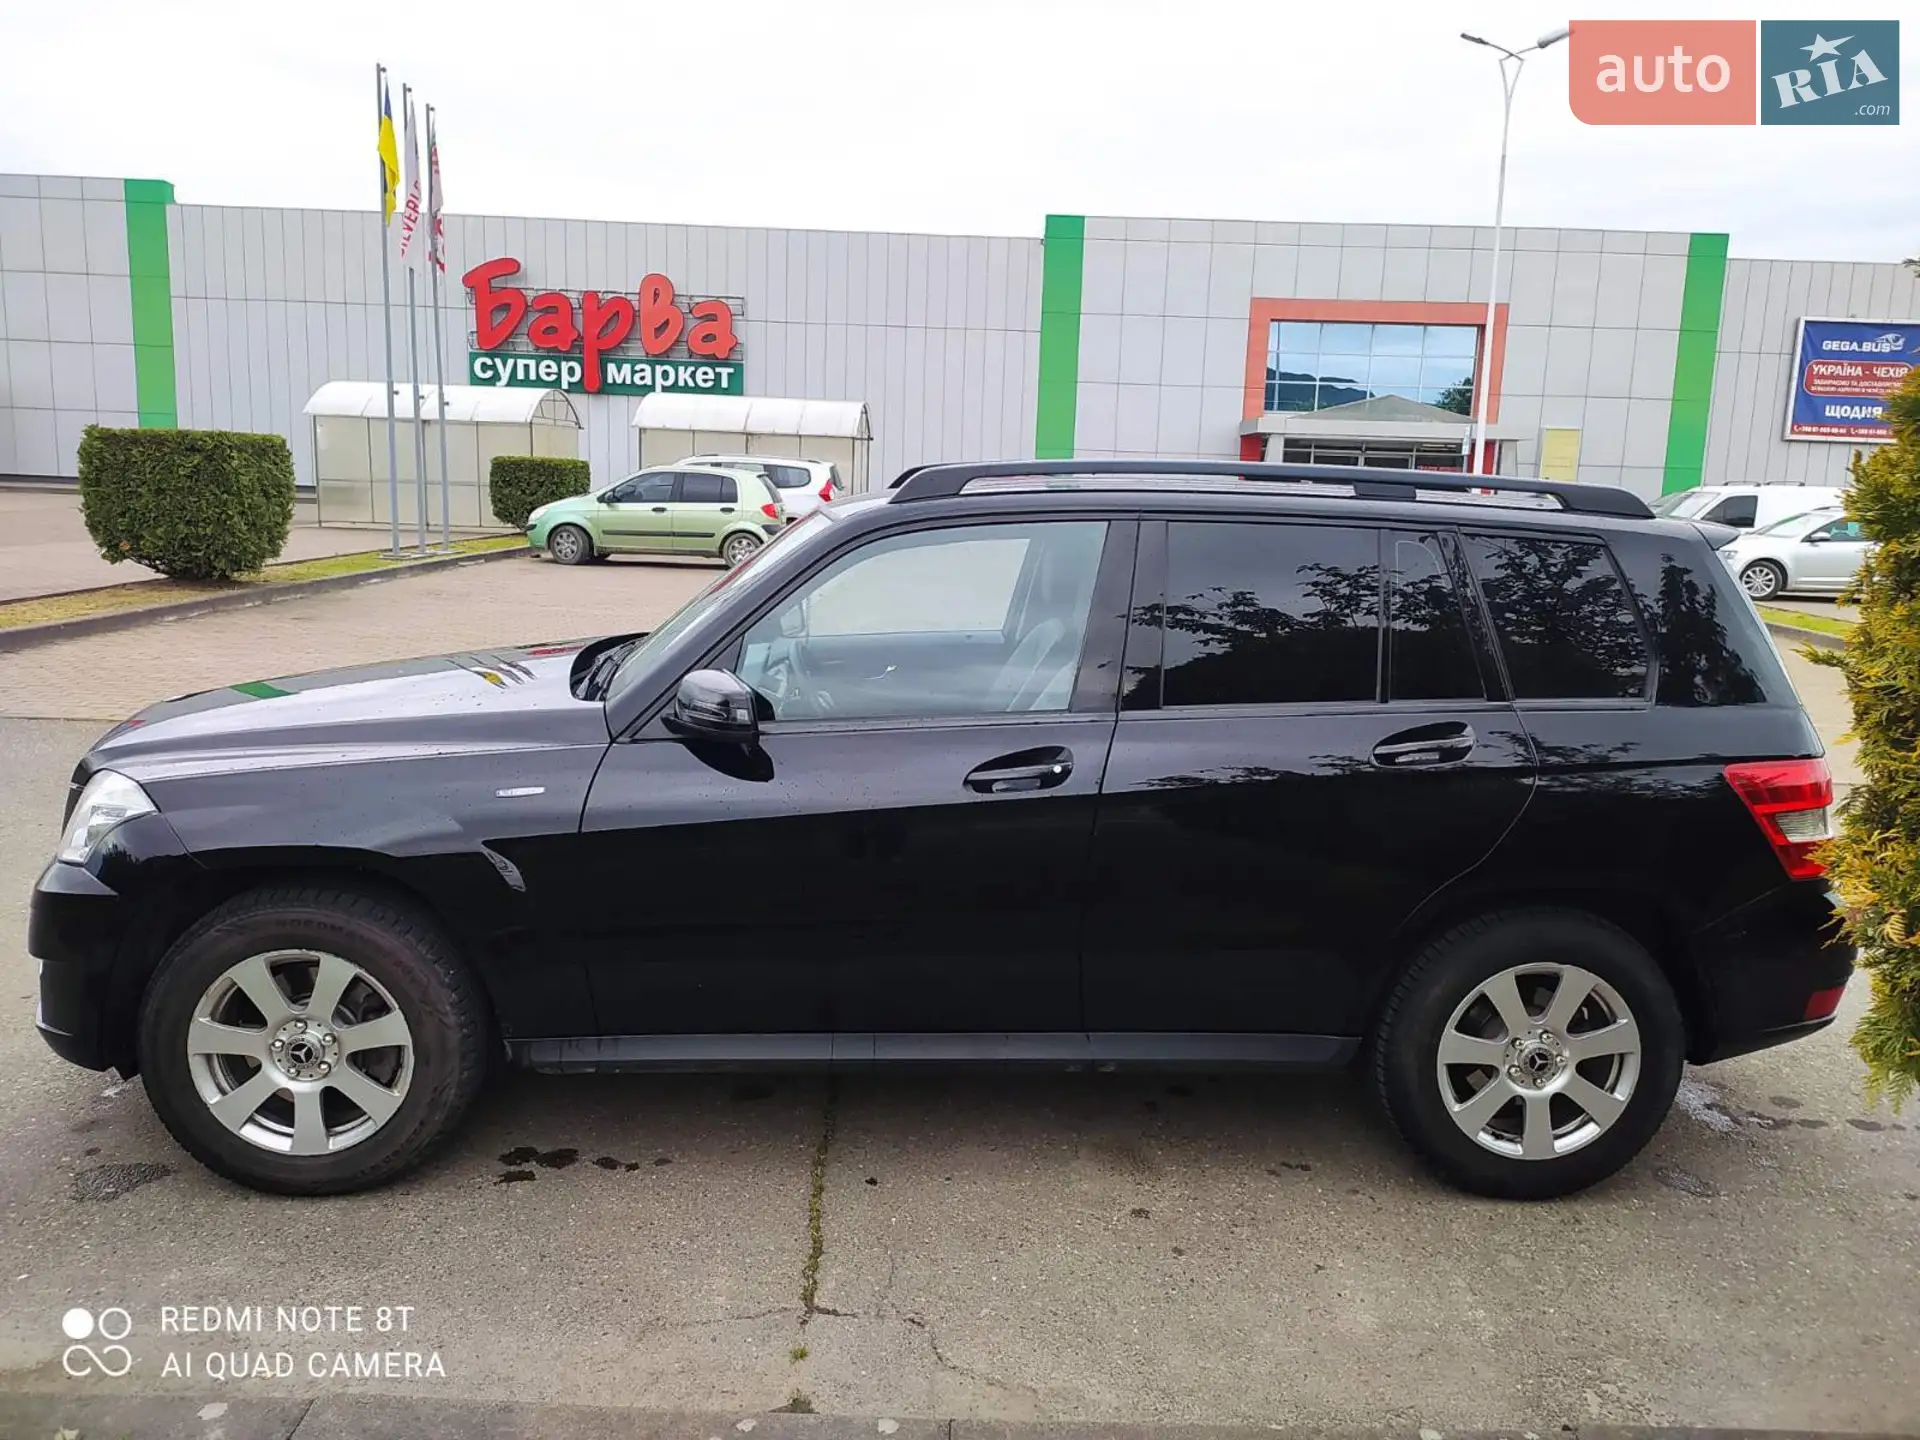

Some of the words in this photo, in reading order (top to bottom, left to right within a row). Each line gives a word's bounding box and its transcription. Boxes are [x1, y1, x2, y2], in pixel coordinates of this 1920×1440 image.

[462, 257, 738, 392] Барва
[1822, 340, 1890, 353] GEGA.BUS
[473, 356, 582, 387] супер
[606, 362, 735, 392] маркет
[1812, 363, 1863, 376] УКРАЇНА
[1873, 366, 1909, 378] ЧЕХІЯ
[1825, 405, 1883, 419] ЩОДНЯ
